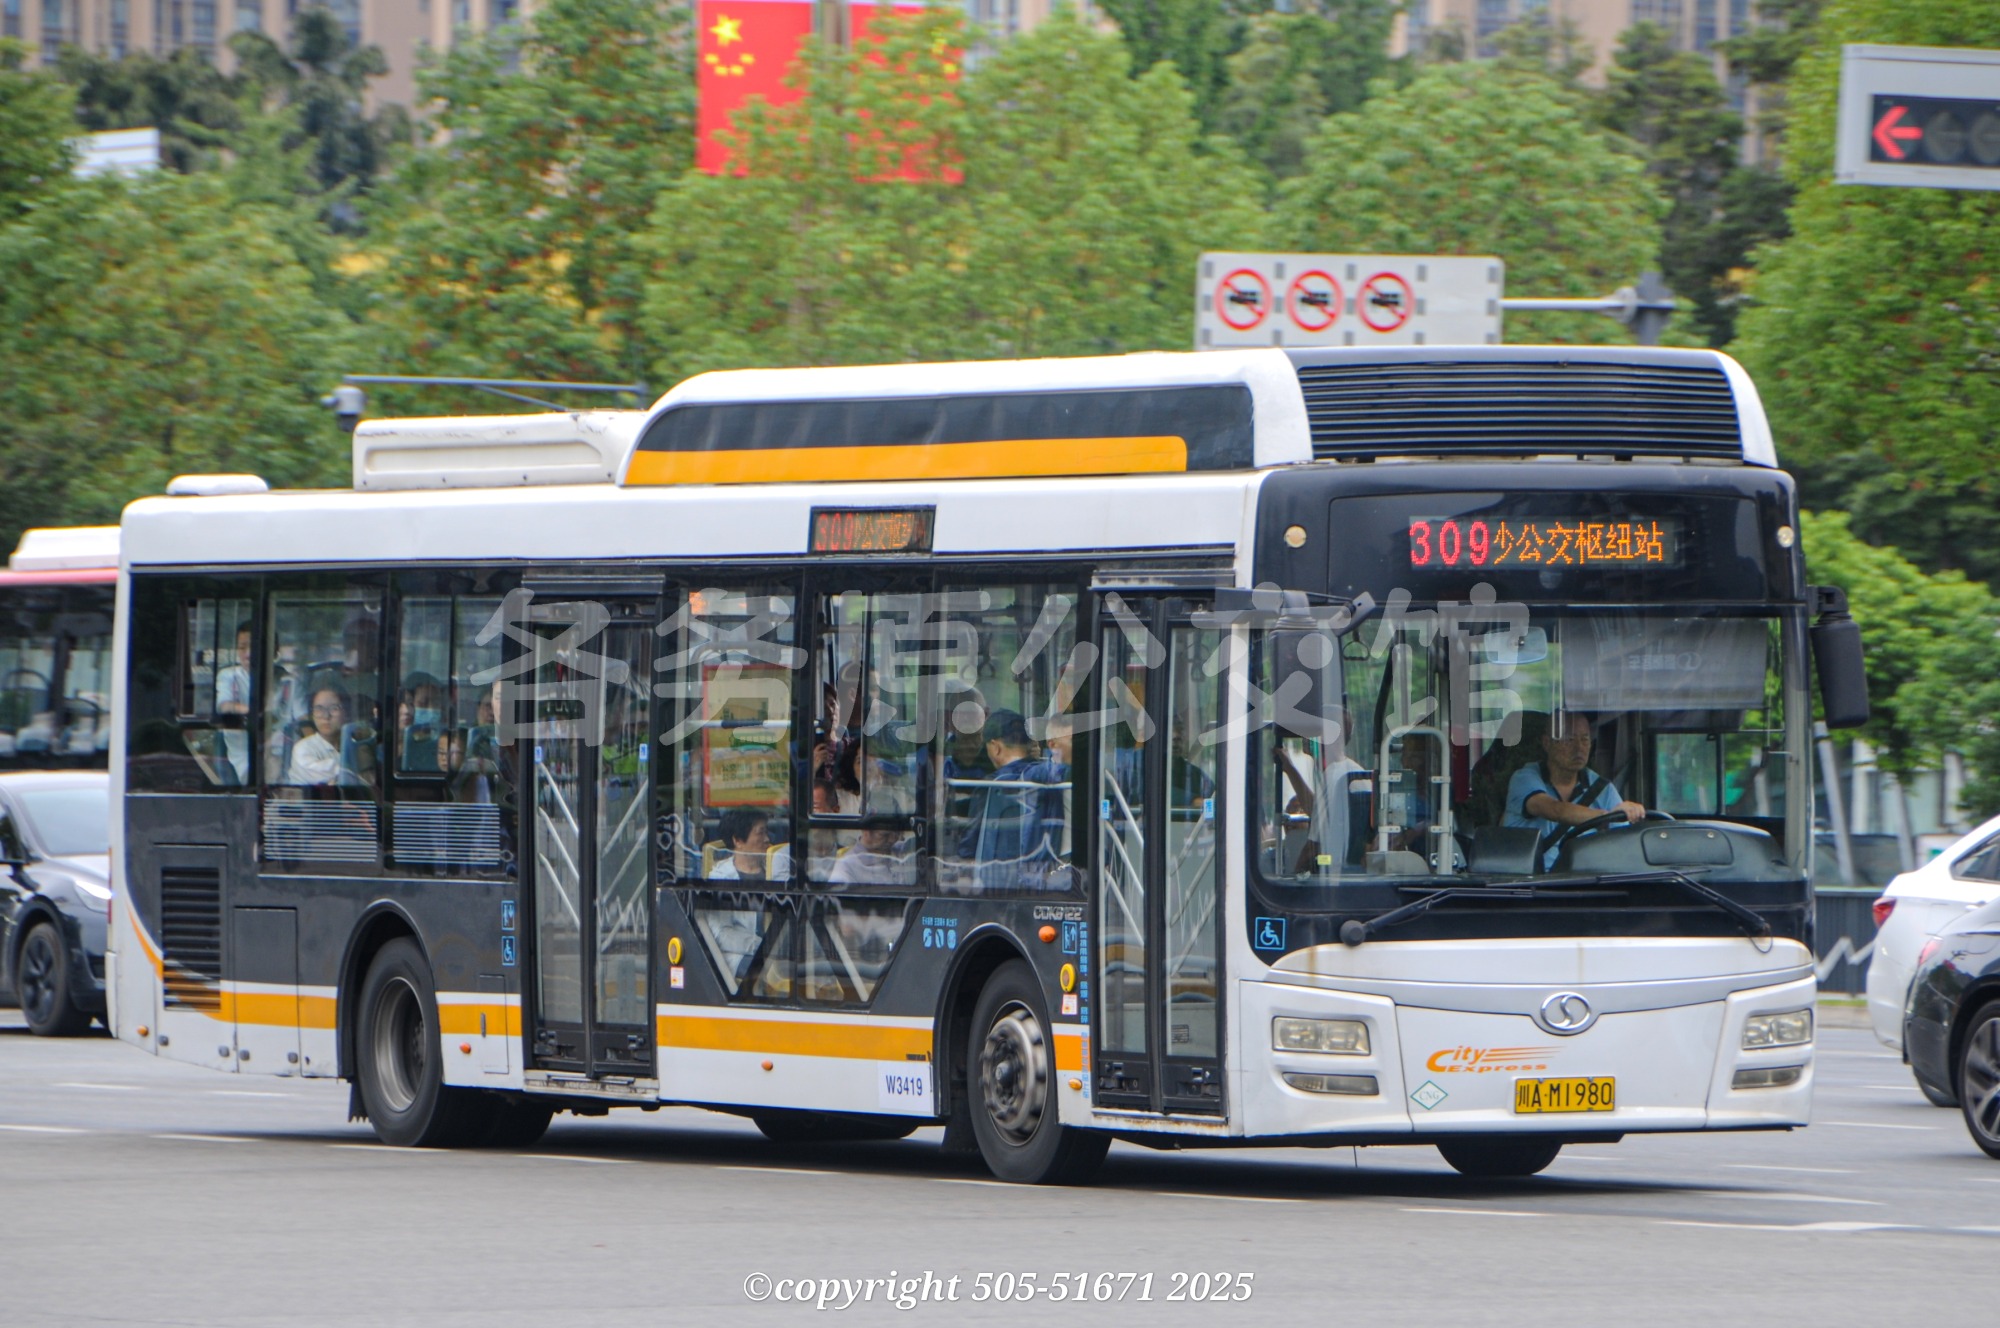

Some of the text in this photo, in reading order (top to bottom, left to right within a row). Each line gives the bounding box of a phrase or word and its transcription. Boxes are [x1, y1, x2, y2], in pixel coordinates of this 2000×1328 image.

[1409, 521, 1490, 565] 309
[1426, 1045, 1487, 1073] City
[1446, 1064, 1548, 1074] Express
[885, 1074, 923, 1096] W3419
[1419, 1090, 1440, 1101] CNG
